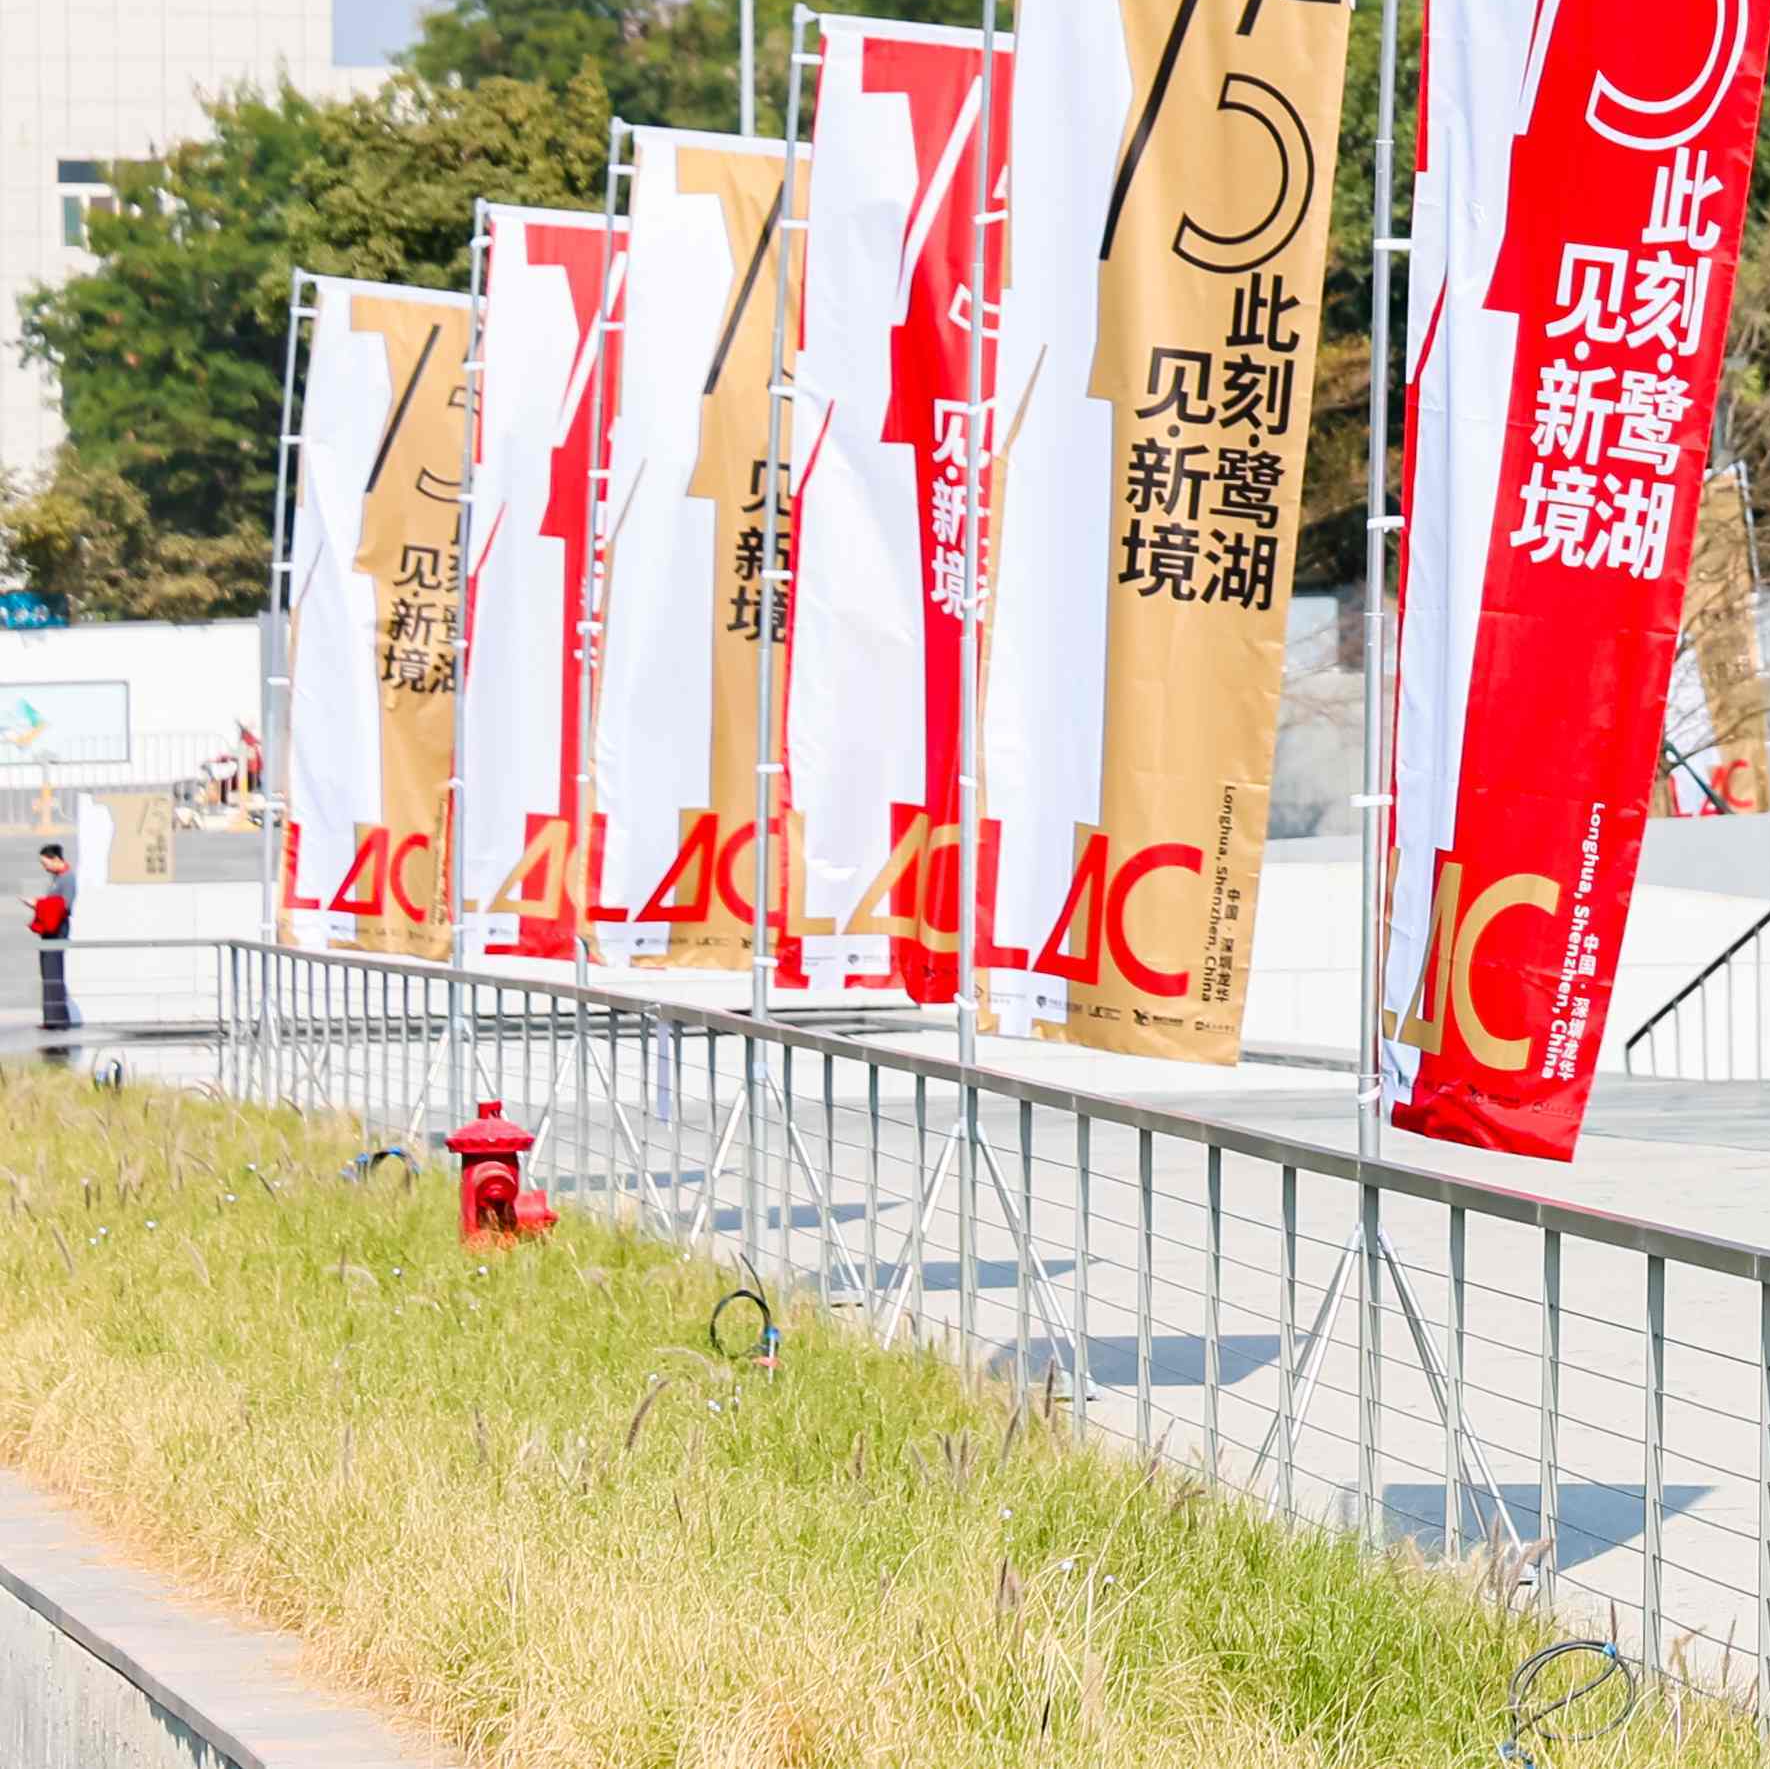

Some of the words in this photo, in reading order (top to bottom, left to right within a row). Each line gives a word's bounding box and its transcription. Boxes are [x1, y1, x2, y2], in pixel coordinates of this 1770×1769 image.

[727, 459, 792, 644] 见新境
[282, 820, 431, 925] LAC
[585, 812, 781, 927] LAC
[1216, 784, 1238, 862] Longhua,
[1571, 801, 1607, 901] Longhua,
[975, 819, 1204, 998] LAC
[1203, 865, 1230, 952] Shenzhen,
[1383, 847, 1560, 1072] AC
[1550, 906, 1591, 1015] Shenzhen,
[1200, 954, 1219, 1004] China
[1540, 1019, 1567, 1080] China
